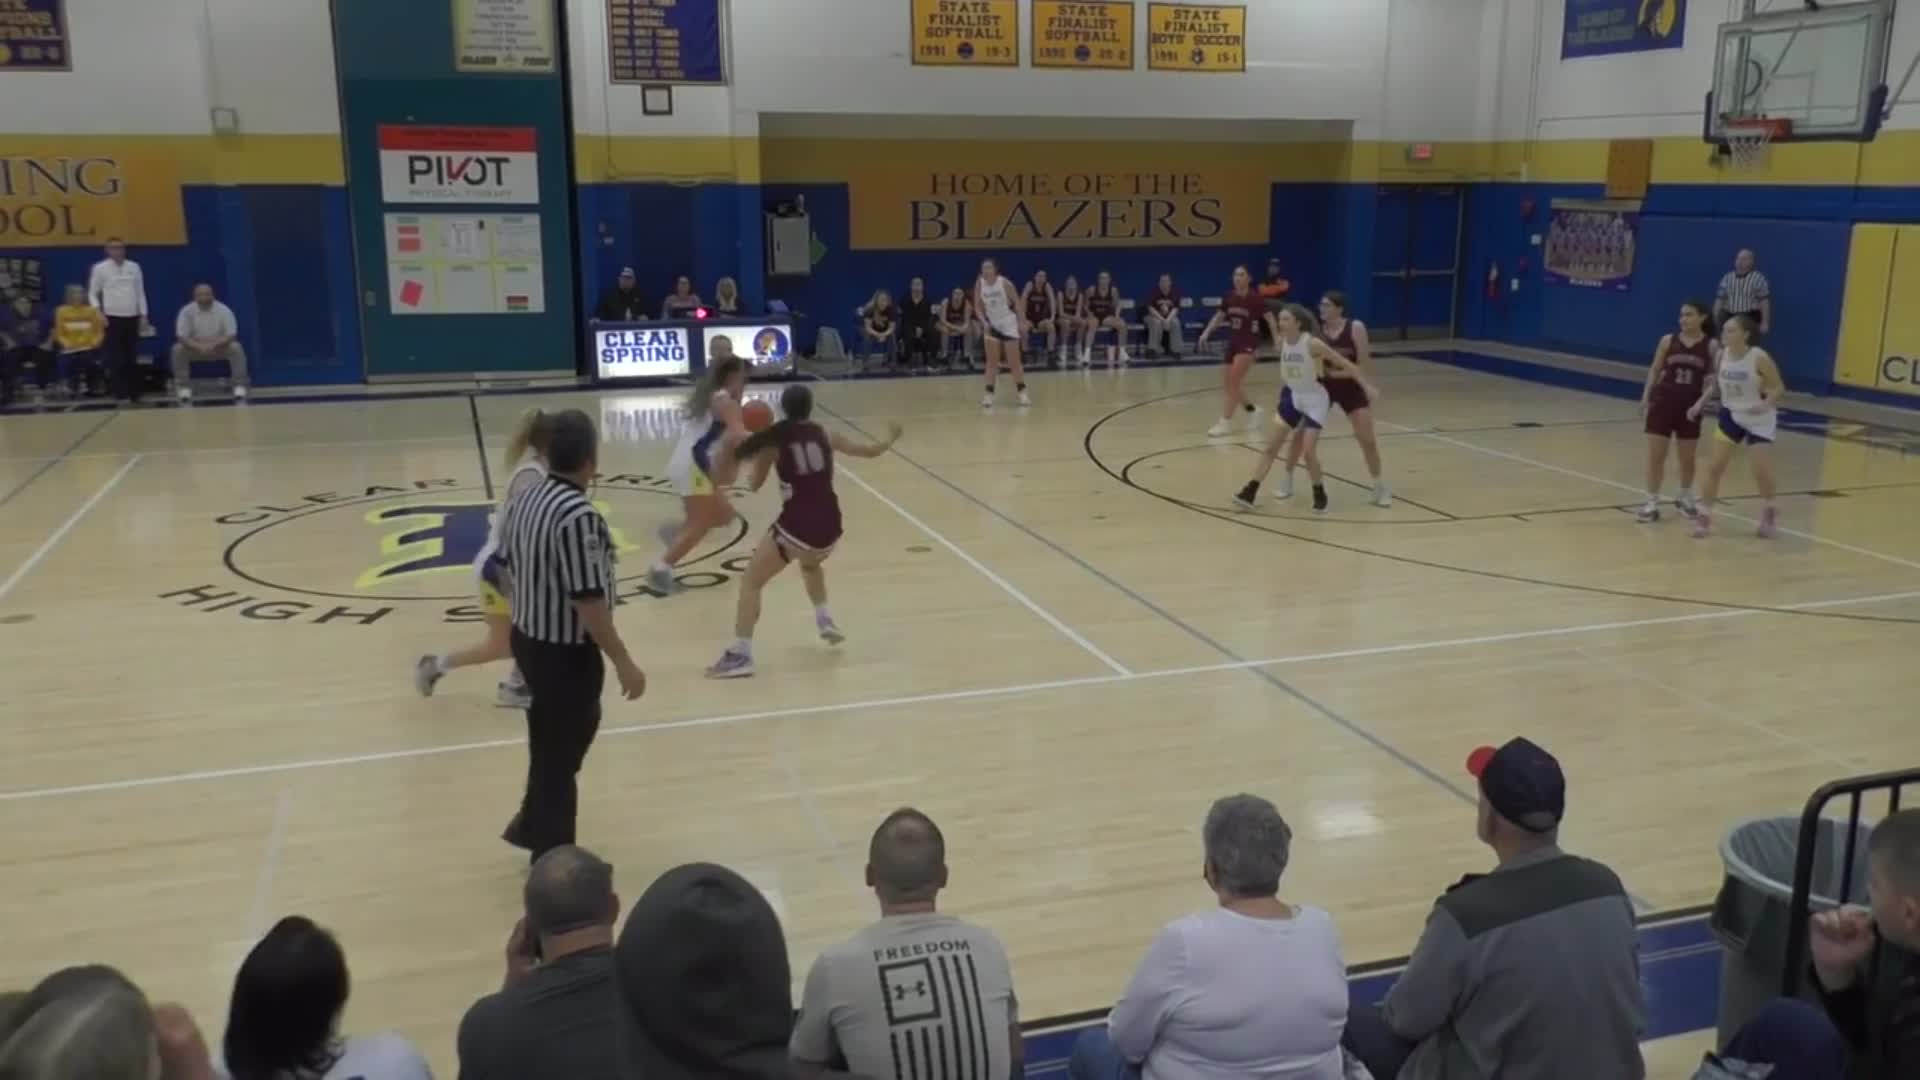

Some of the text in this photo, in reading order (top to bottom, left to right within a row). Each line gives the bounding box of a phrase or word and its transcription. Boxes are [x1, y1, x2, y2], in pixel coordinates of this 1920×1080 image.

[939, 1, 990, 13] STATE
[1058, 4, 1107, 17] STATE
[928, 14, 1001, 27] FINALIST
[1173, 9, 1221, 21] STATE
[1048, 17, 1117, 30] FINALIST
[1164, 21, 1230, 34] FINALIST
[926, 27, 1004, 40] SOFTBALL
[1045, 29, 1121, 43] SOFTBALL
[1193, 35, 1241, 46] SOCCER
[408, 155, 511, 186] PIVOT
[930, 173, 1203, 196] HOME OF THE
[908, 198, 1223, 241] BLAZERS
[605, 331, 679, 347] CLEAR
[601, 347, 684, 364] SPRING
[789, 441, 825, 475] 10
[157, 584, 394, 625] HIGH
[873, 940, 970, 962] FREEDOM
